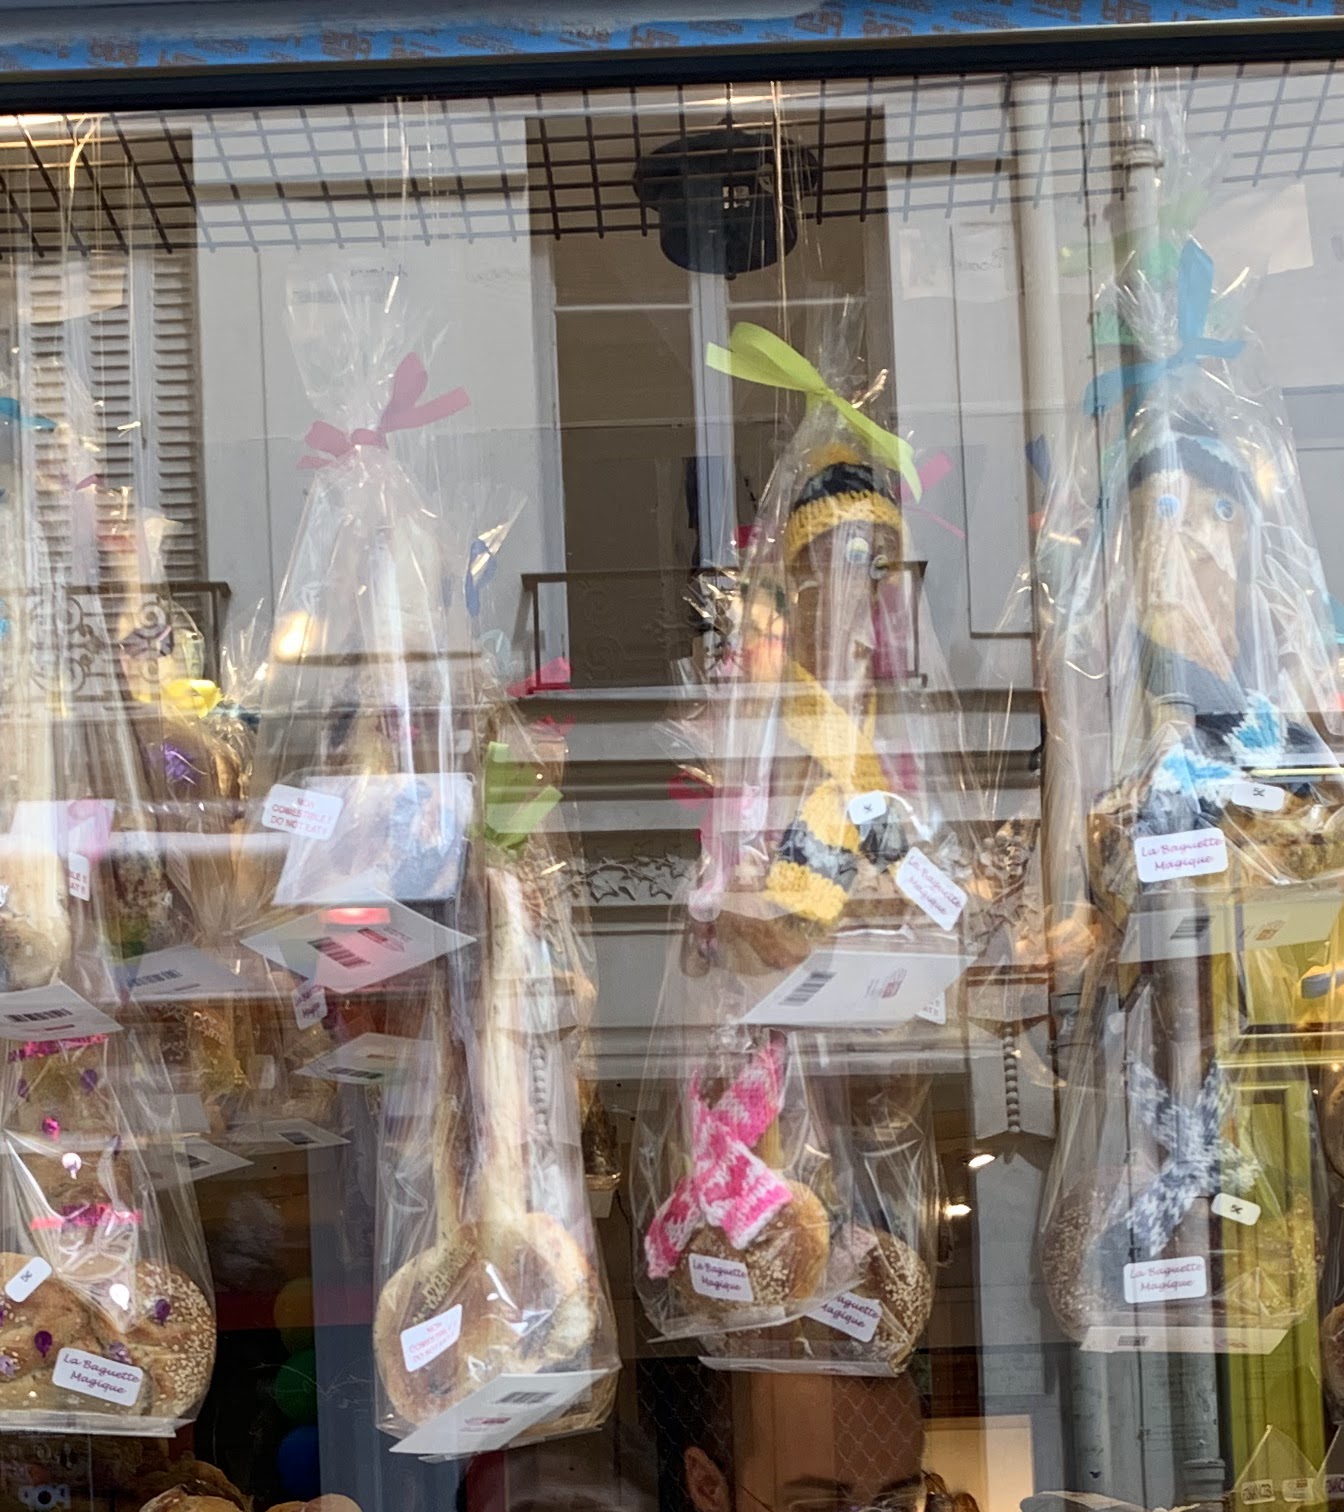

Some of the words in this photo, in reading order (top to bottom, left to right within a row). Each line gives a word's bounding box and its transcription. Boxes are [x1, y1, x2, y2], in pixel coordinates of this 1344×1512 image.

[1141, 847, 1158, 857] La
[1161, 838, 1223, 855] Baguette
[1155, 856, 1213, 872] Magique
[63, 1353, 80, 1365] La
[83, 1359, 141, 1383] Baguette
[70, 1370, 128, 1394] Magique
